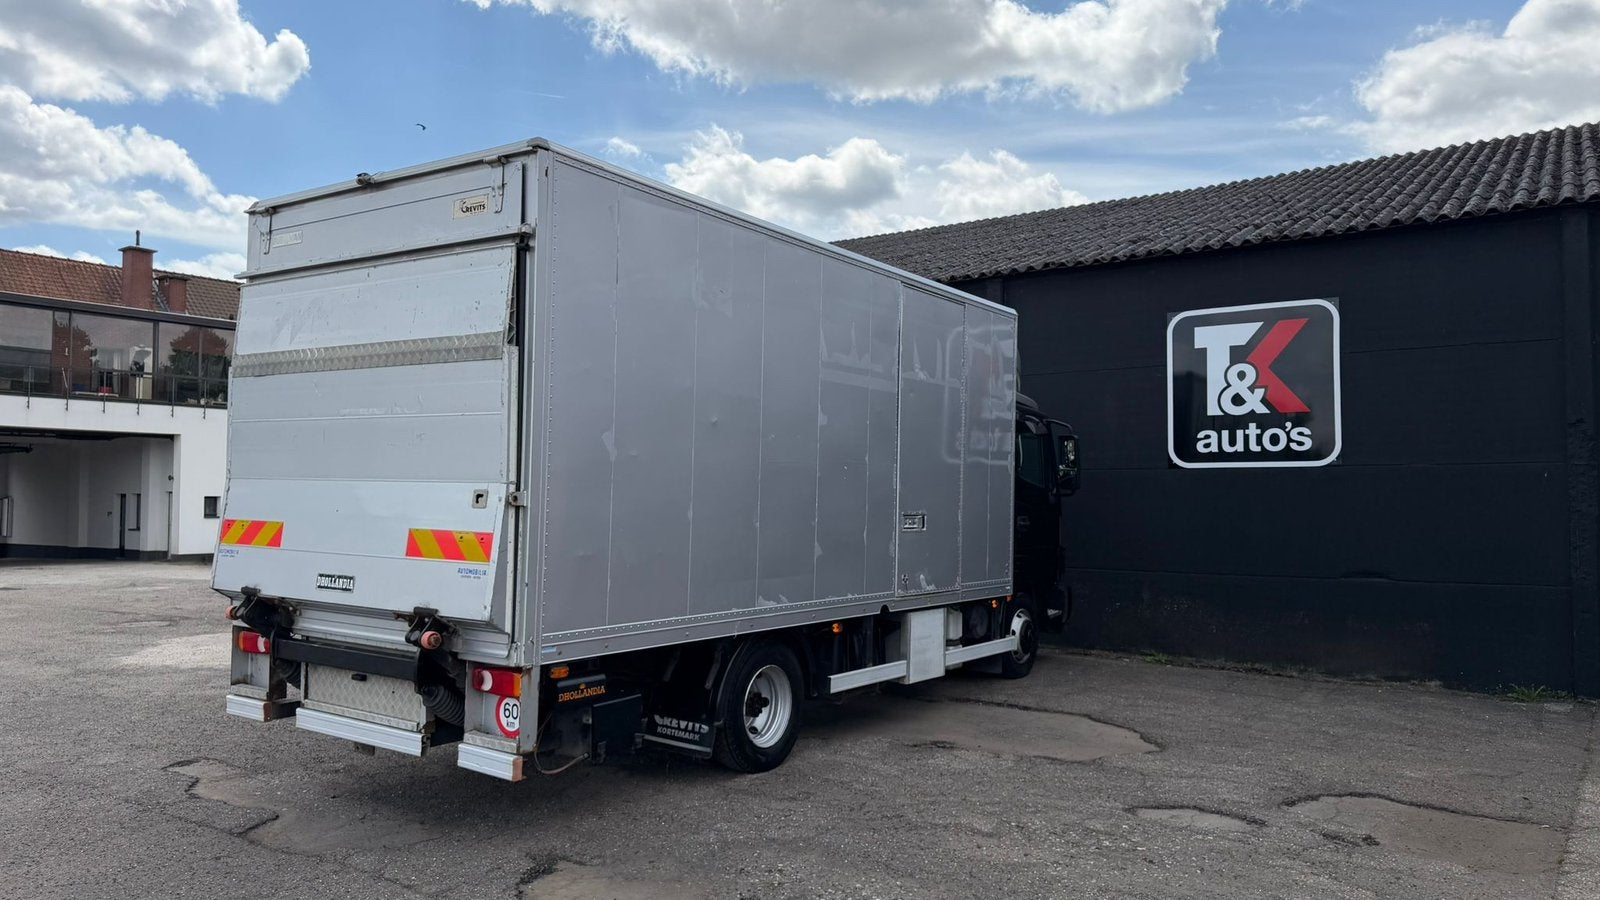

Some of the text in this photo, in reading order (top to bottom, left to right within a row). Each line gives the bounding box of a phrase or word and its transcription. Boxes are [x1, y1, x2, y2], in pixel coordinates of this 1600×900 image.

[1194, 318, 1312, 416] T&K
[1196, 421, 1313, 453] auto's
[316, 575, 354, 589] DHOLLANDIA
[558, 685, 606, 702] DHOLLANDIA
[503, 702, 519, 720] 60
[506, 719, 516, 728] km
[656, 726, 701, 741] KORTEMARK
